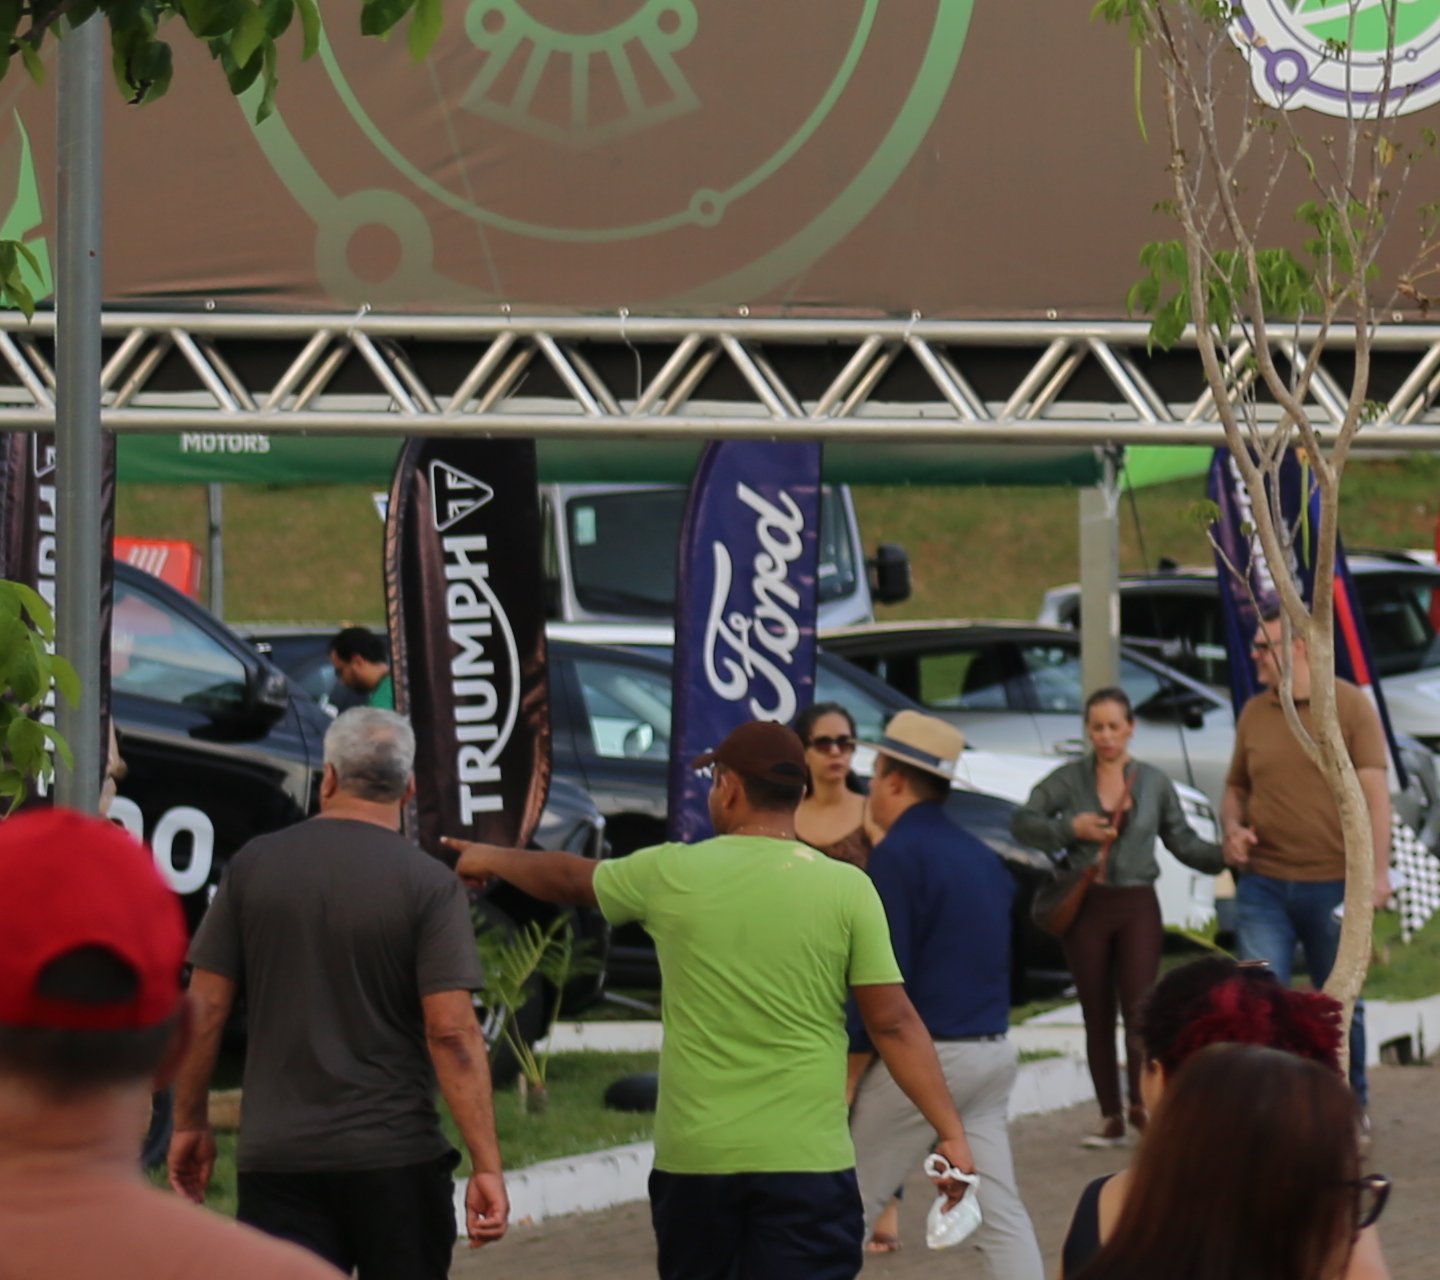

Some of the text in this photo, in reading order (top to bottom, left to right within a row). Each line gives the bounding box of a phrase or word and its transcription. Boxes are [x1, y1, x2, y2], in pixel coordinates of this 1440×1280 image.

[181, 432, 271, 454] MOTORS
[442, 534, 521, 826] TRIUMPH
[703, 480, 805, 725] Ford
